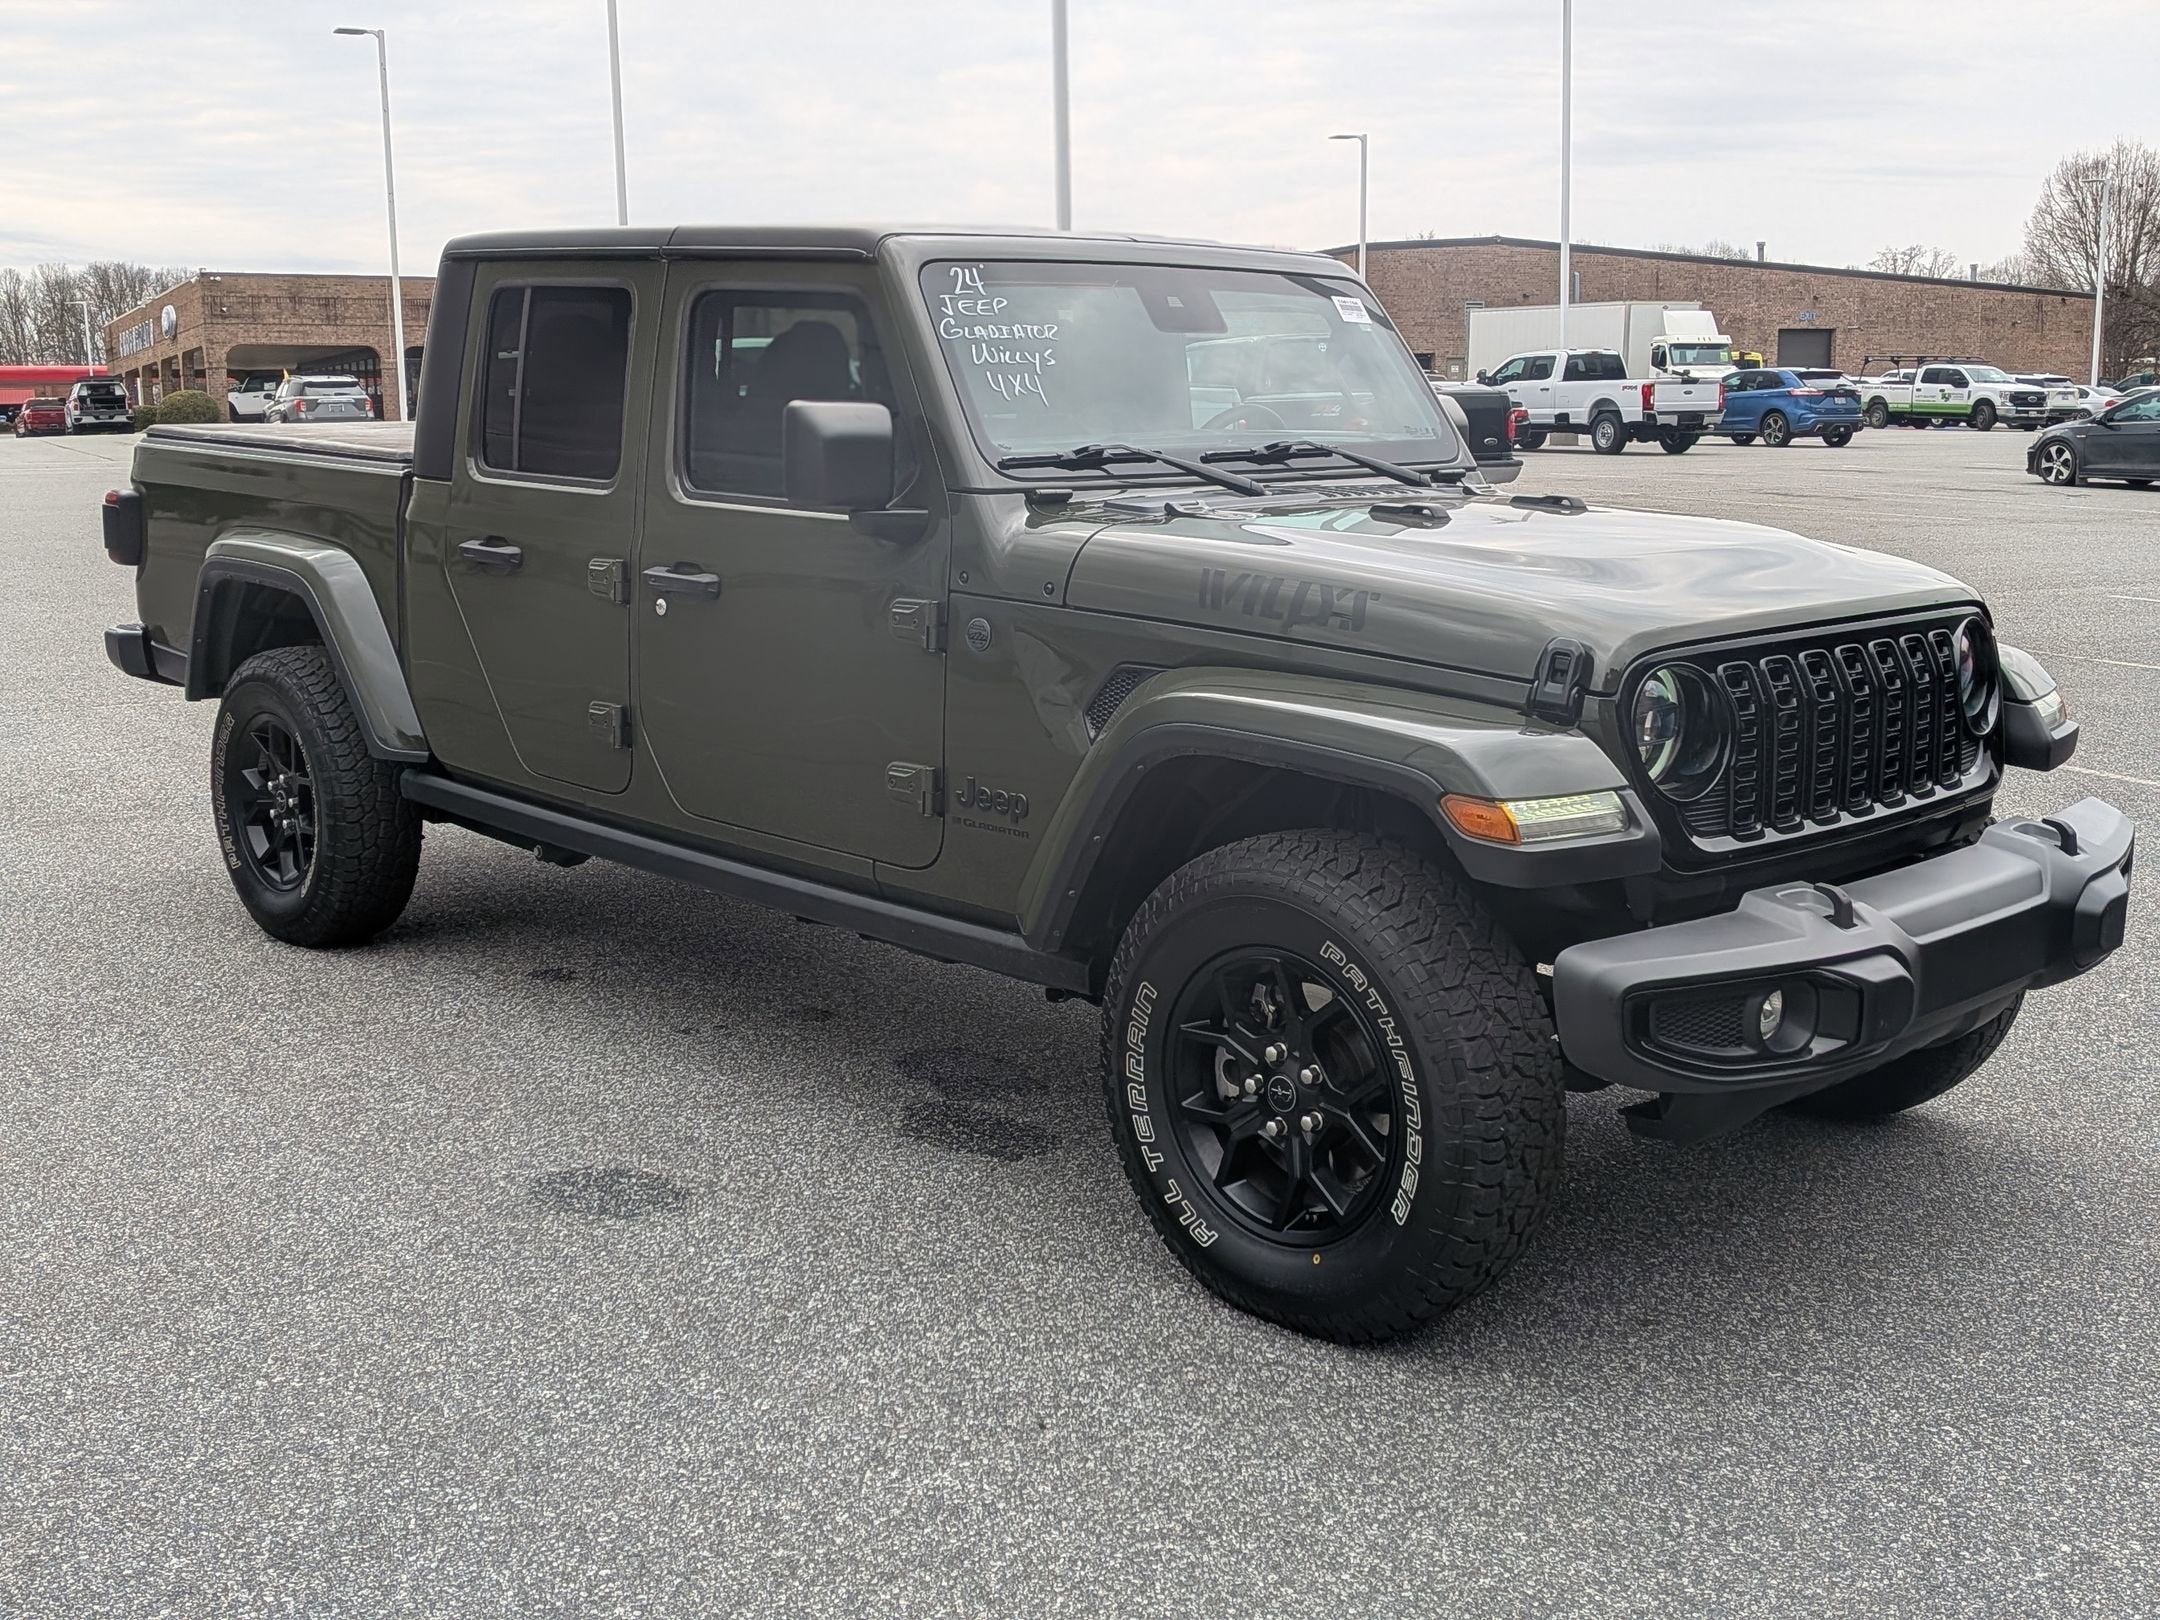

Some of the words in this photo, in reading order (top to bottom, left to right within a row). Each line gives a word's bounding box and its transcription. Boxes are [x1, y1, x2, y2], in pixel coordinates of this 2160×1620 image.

[940, 294, 1008, 316] JEEP
[940, 318, 1059, 341] GLADIATOR
[955, 776, 1029, 824] Jeep
[963, 818, 1030, 839] GLADIATOR
[1123, 980, 1166, 1174] TERRAIN
[1319, 940, 1424, 1227] PATHFINDER
[1164, 1179, 1219, 1249] ALL
